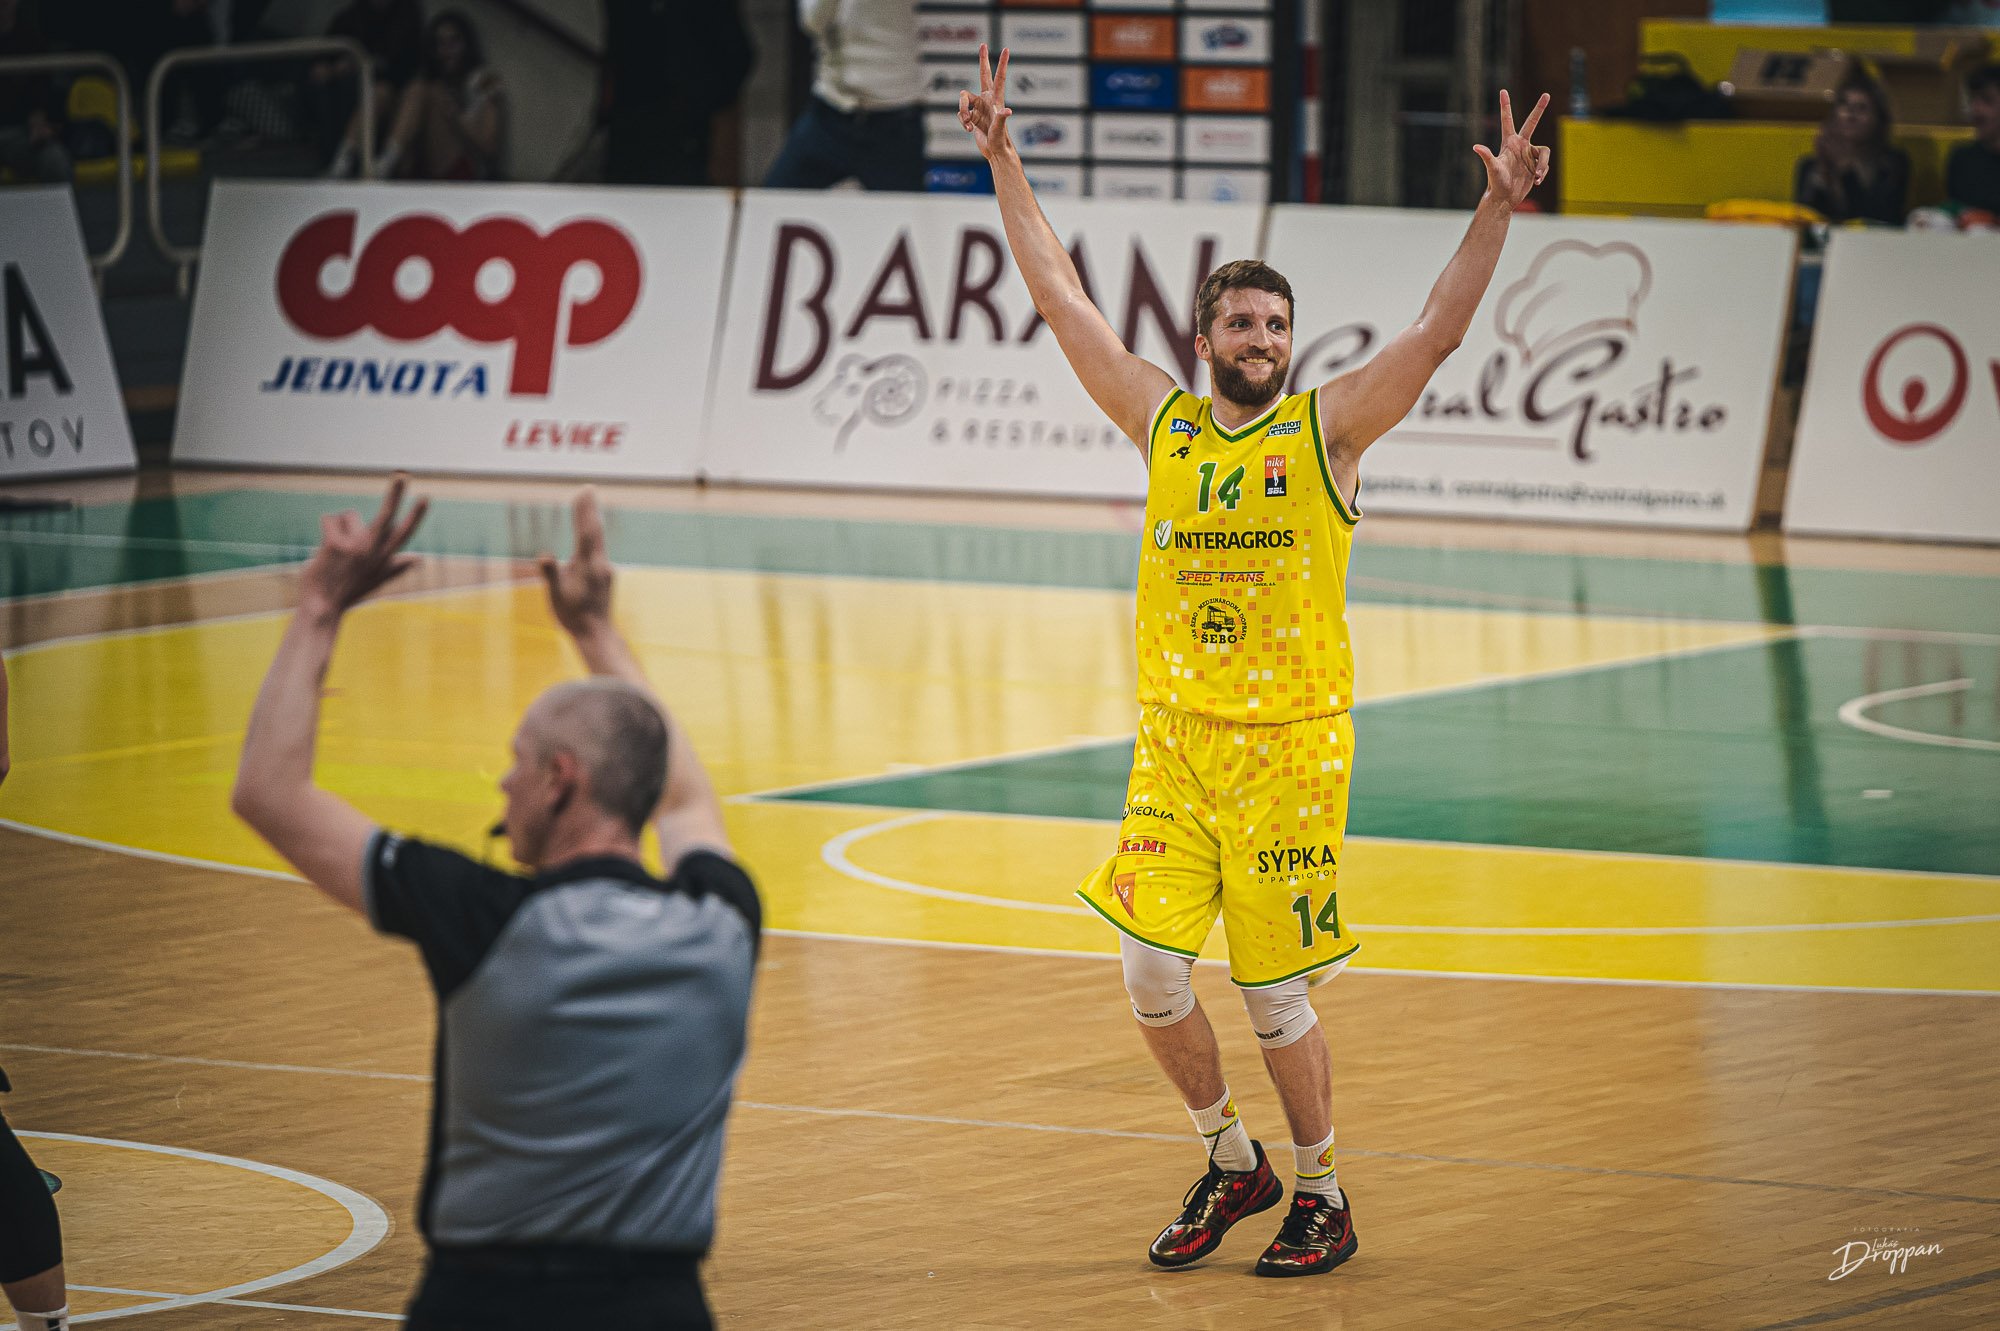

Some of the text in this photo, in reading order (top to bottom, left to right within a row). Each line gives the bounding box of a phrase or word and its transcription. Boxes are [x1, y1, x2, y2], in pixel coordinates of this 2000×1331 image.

[261, 356, 490, 396] JEDNOTA
[936, 377, 1039, 405] PIZZA
[1522, 335, 1729, 462] Gastro
[503, 420, 627, 449] LEVICE
[961, 419, 1117, 451] RESTAUR
[1197, 461, 1245, 513] 14
[1267, 487, 1285, 495] SBL
[1175, 530, 1295, 550] INTERAGROS
[1201, 631, 1238, 644] ŠEBO
[1130, 806, 1175, 821] VEOLIA
[1258, 840, 1337, 874] SÝPKA
[1271, 869, 1338, 884] PATRIOTOV
[1291, 890, 1341, 949] 14
